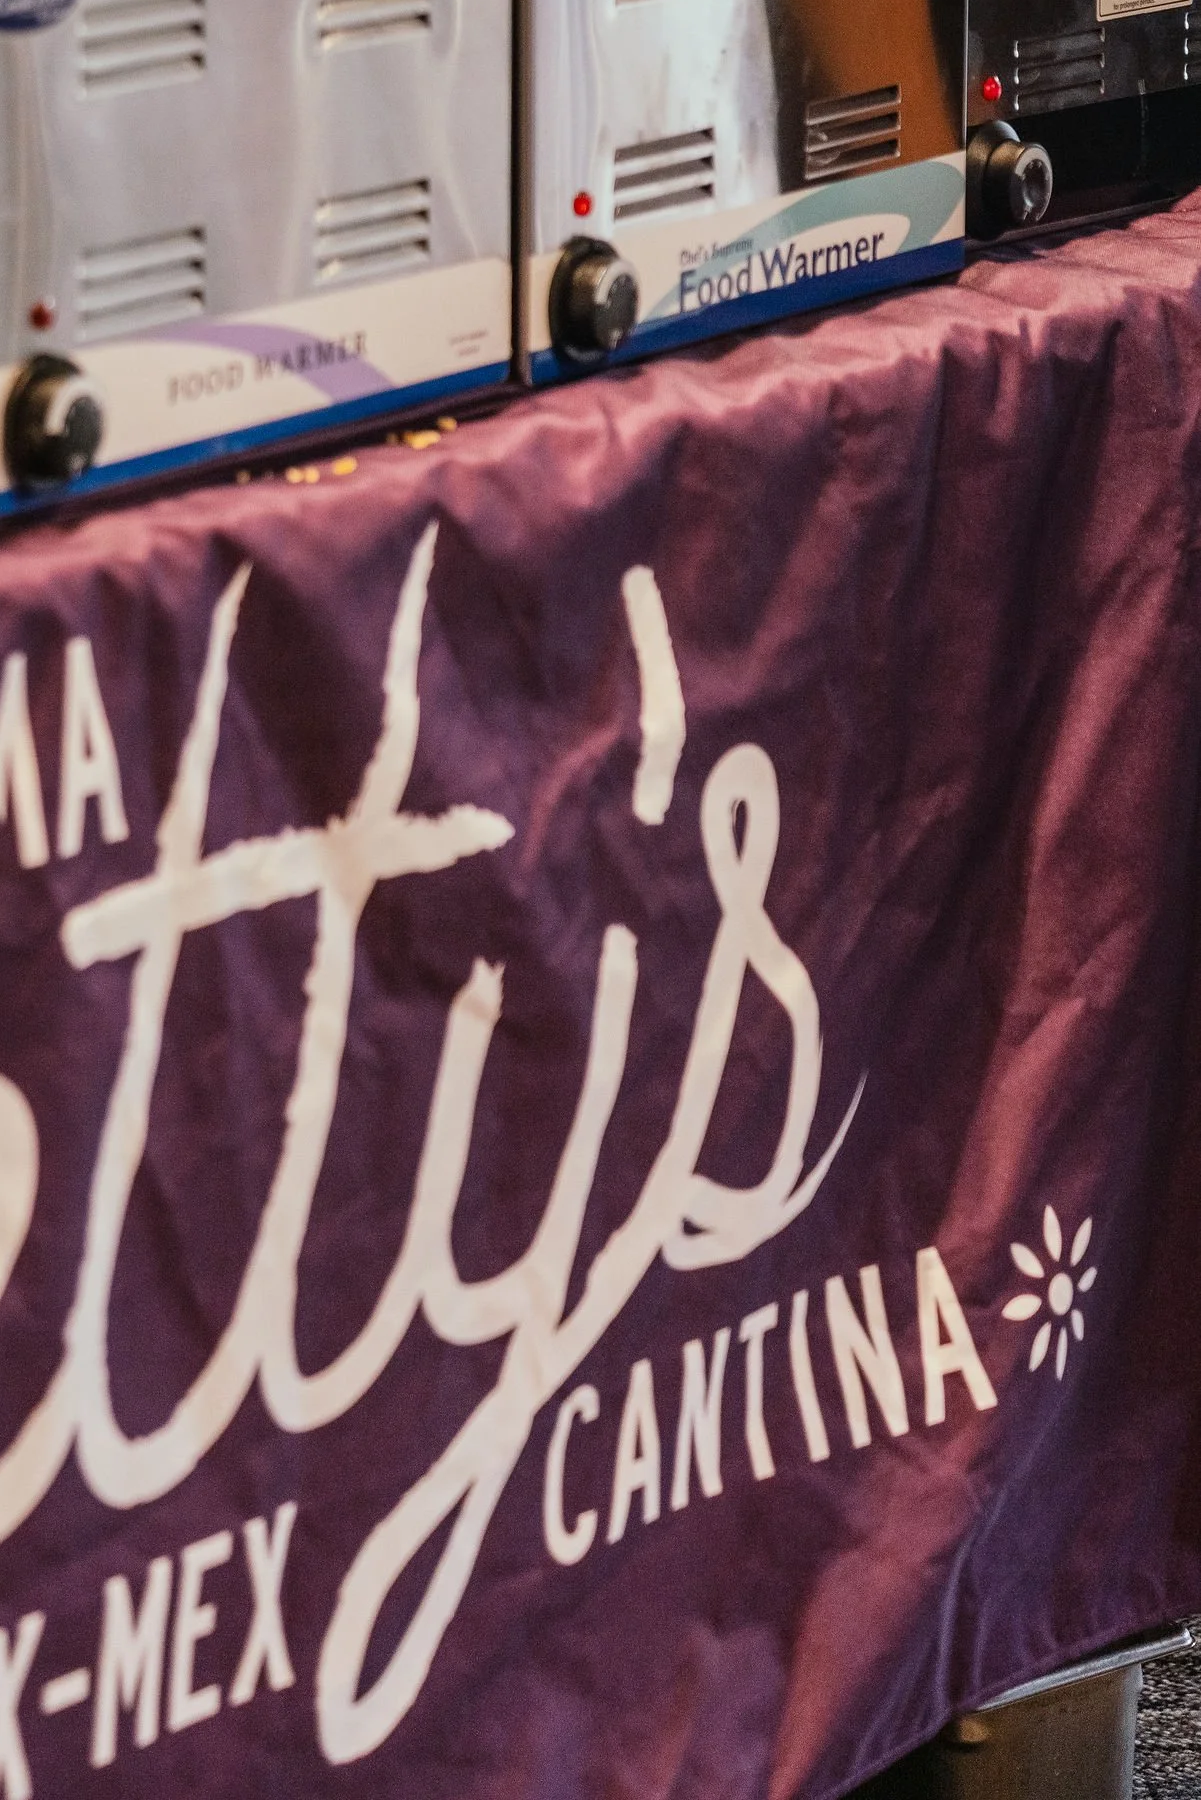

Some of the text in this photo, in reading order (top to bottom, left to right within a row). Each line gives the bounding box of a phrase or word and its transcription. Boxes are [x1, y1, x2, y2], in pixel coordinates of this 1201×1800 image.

[679, 232, 885, 313] Food Warmer
[168, 330, 367, 406] FOOD WARMER
[543, 1245, 999, 1566] CANTINA
